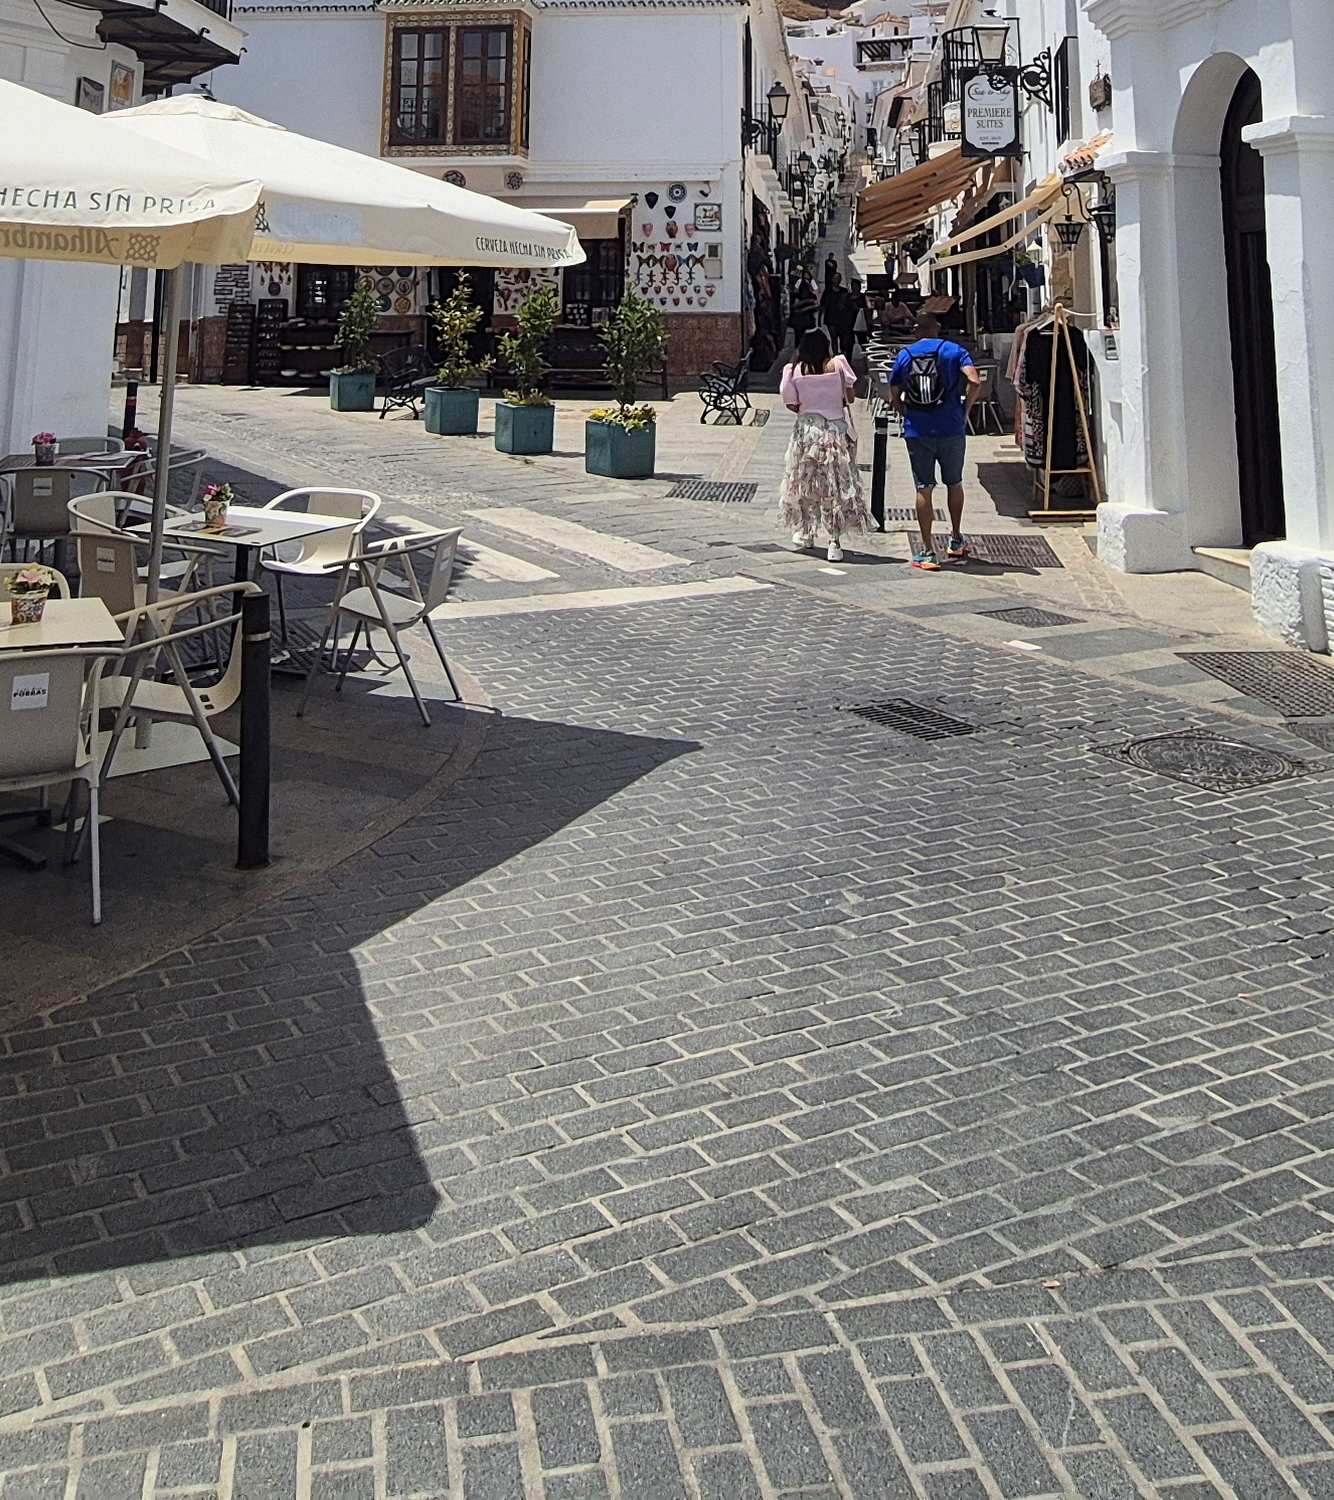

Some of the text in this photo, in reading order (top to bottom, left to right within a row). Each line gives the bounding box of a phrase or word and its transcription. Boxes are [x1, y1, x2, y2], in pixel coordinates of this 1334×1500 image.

[968, 108, 1012, 118] PREMIERE
[976, 120, 1004, 129] SUITES
[89, 191, 132, 214] SIN
[142, 195, 217, 215] PRISA
[475, 237, 508, 253] CERVEZA
[509, 241, 532, 257] HECHA
